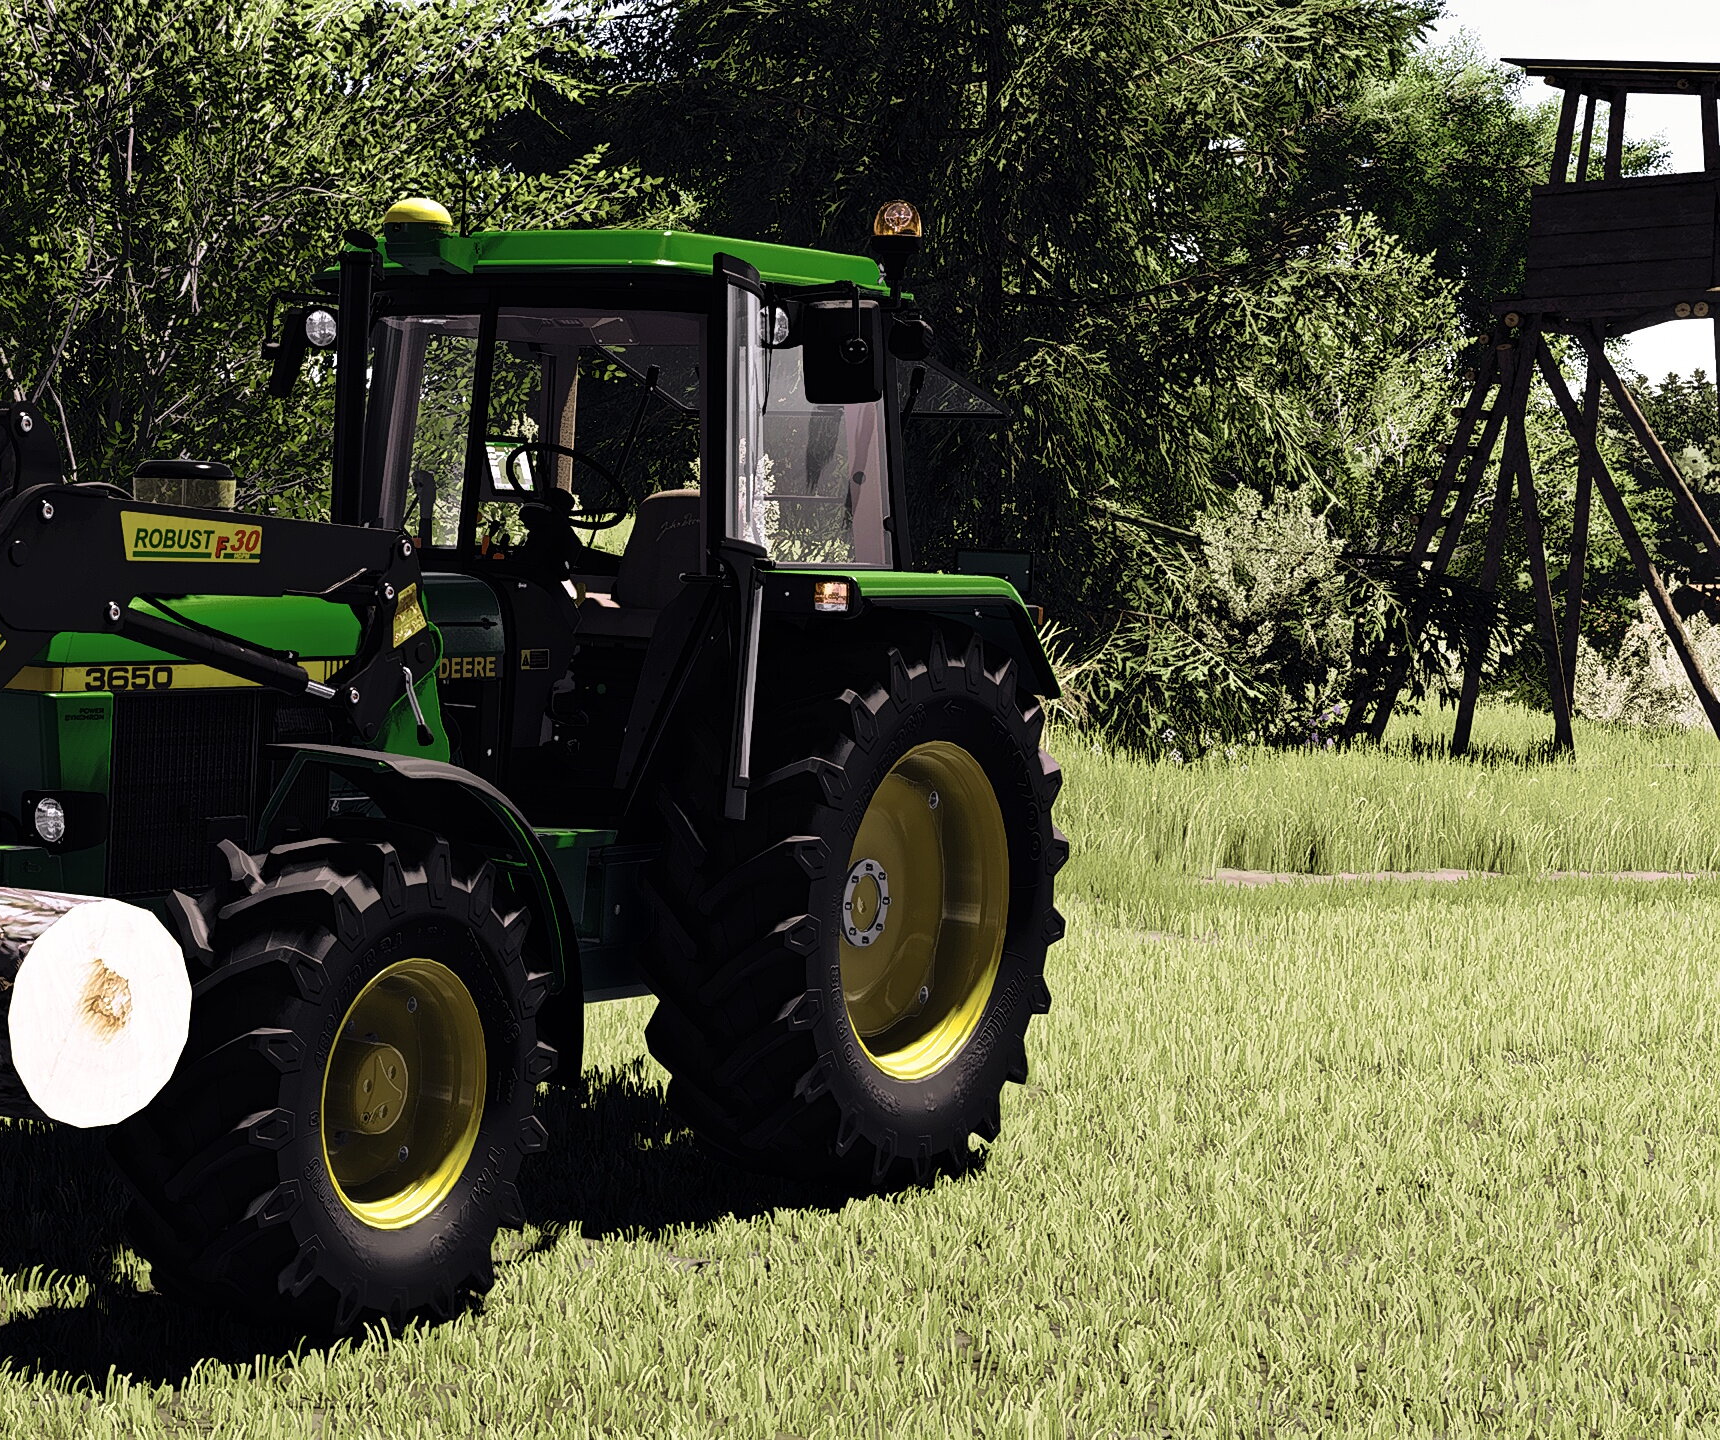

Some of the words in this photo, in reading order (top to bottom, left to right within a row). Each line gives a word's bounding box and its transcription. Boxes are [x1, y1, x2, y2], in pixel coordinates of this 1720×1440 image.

[134, 528, 216, 550] ROBUST
[85, 667, 173, 690] 3650
[438, 656, 497, 679] DEERE
